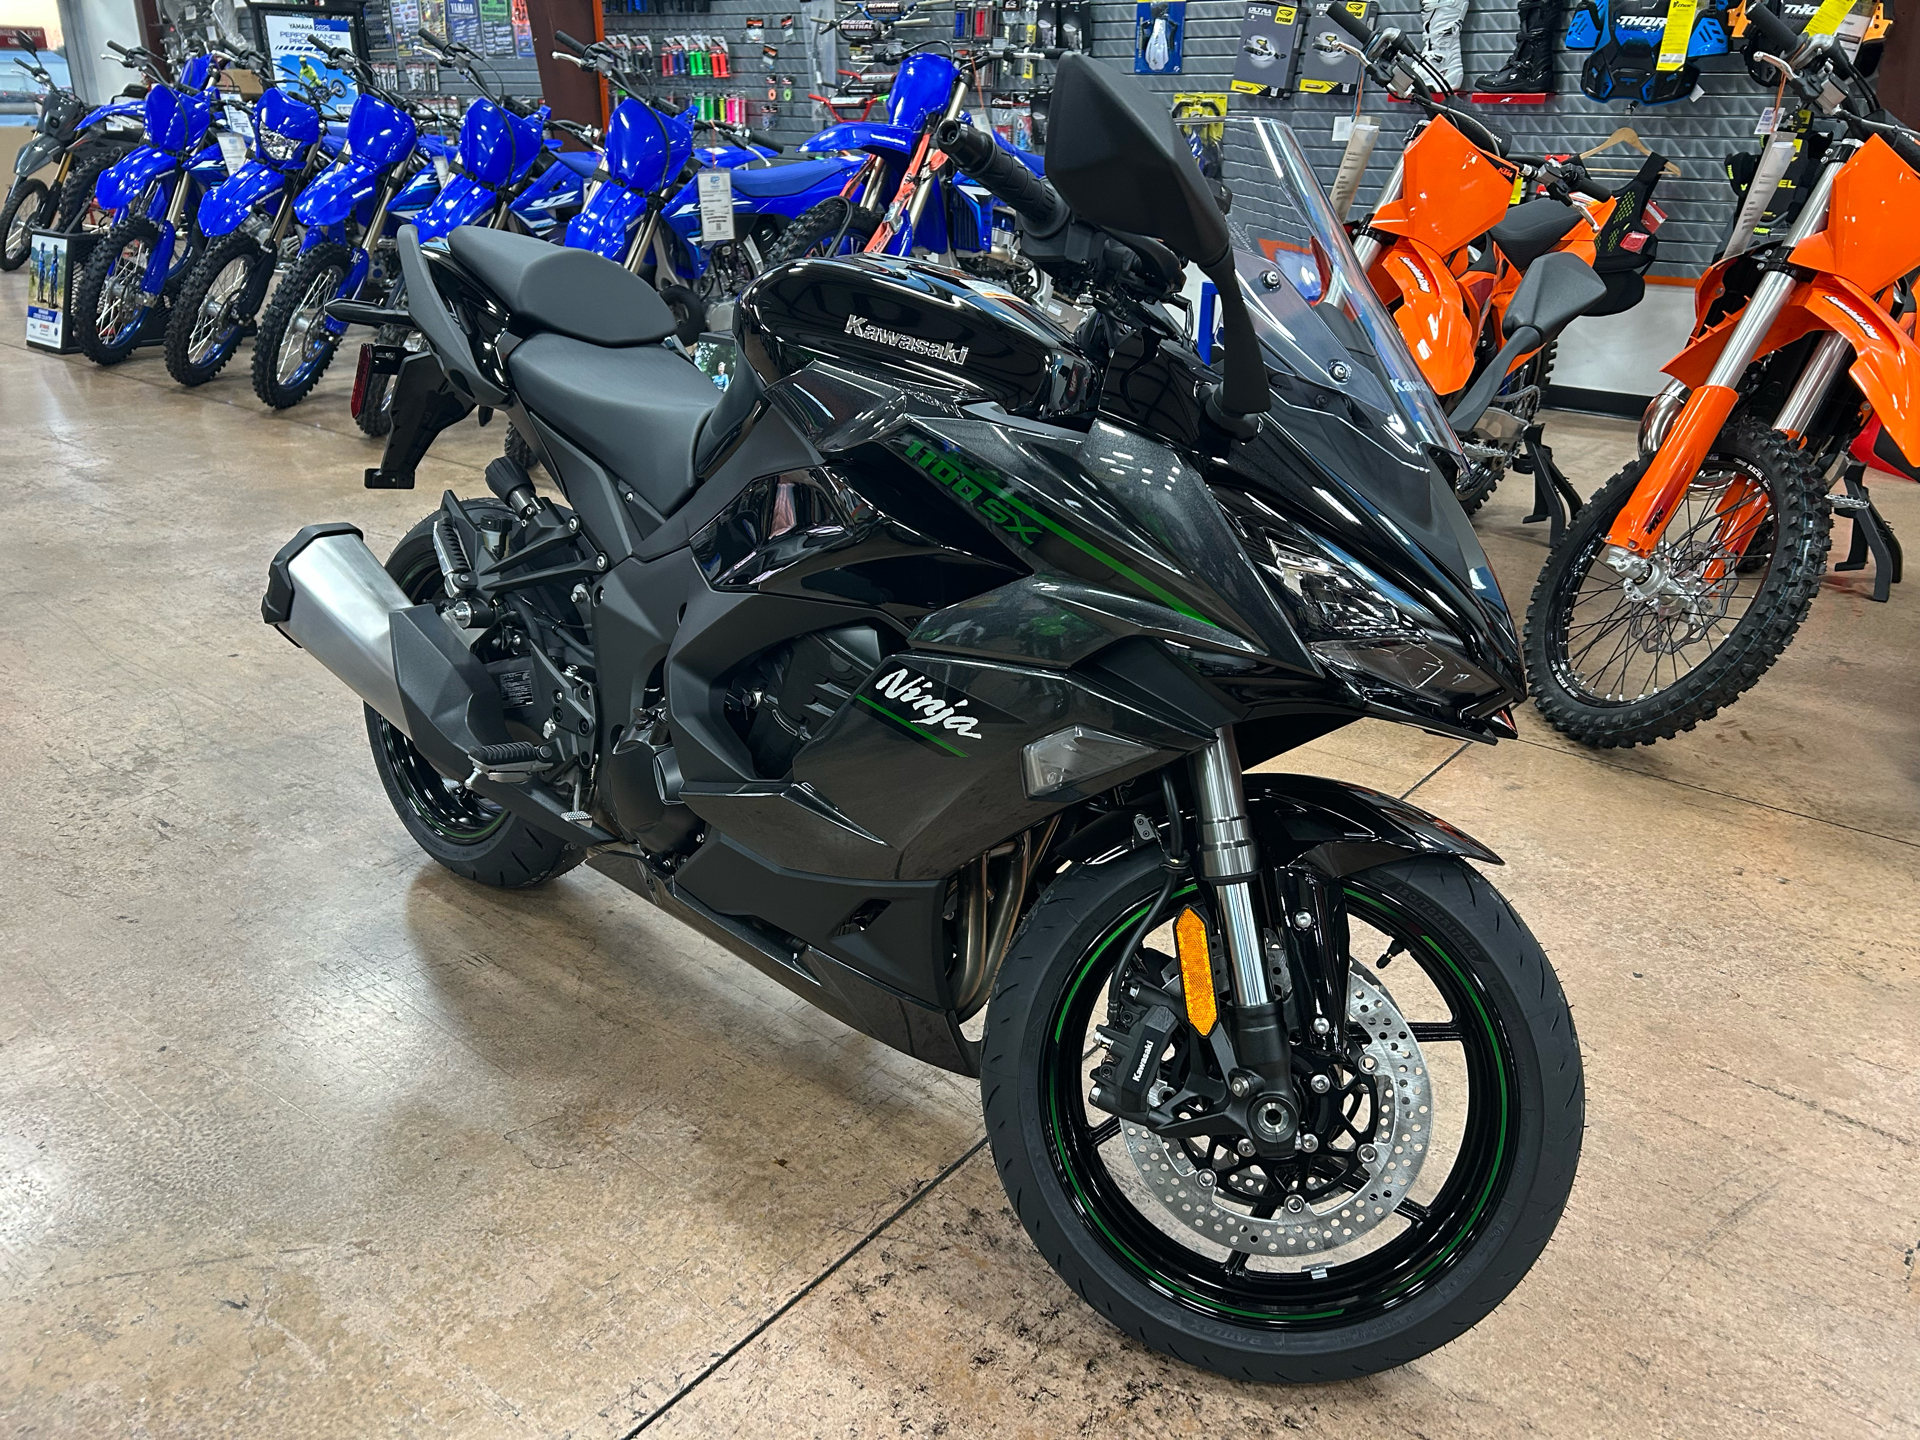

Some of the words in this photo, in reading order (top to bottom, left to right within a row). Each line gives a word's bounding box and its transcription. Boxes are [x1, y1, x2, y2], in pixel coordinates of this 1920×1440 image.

[450, 3, 474, 14] YAMAHA
[1619, 15, 1668, 27] THOR
[1784, 4, 1821, 15] THO
[315, 24, 331, 32] 2025
[844, 314, 969, 365] Kawasaki
[904, 439, 983, 503] 1100
[977, 498, 1043, 545] SX
[875, 668, 982, 740] Ninja
[1132, 1039, 1154, 1083] Kawasaki
